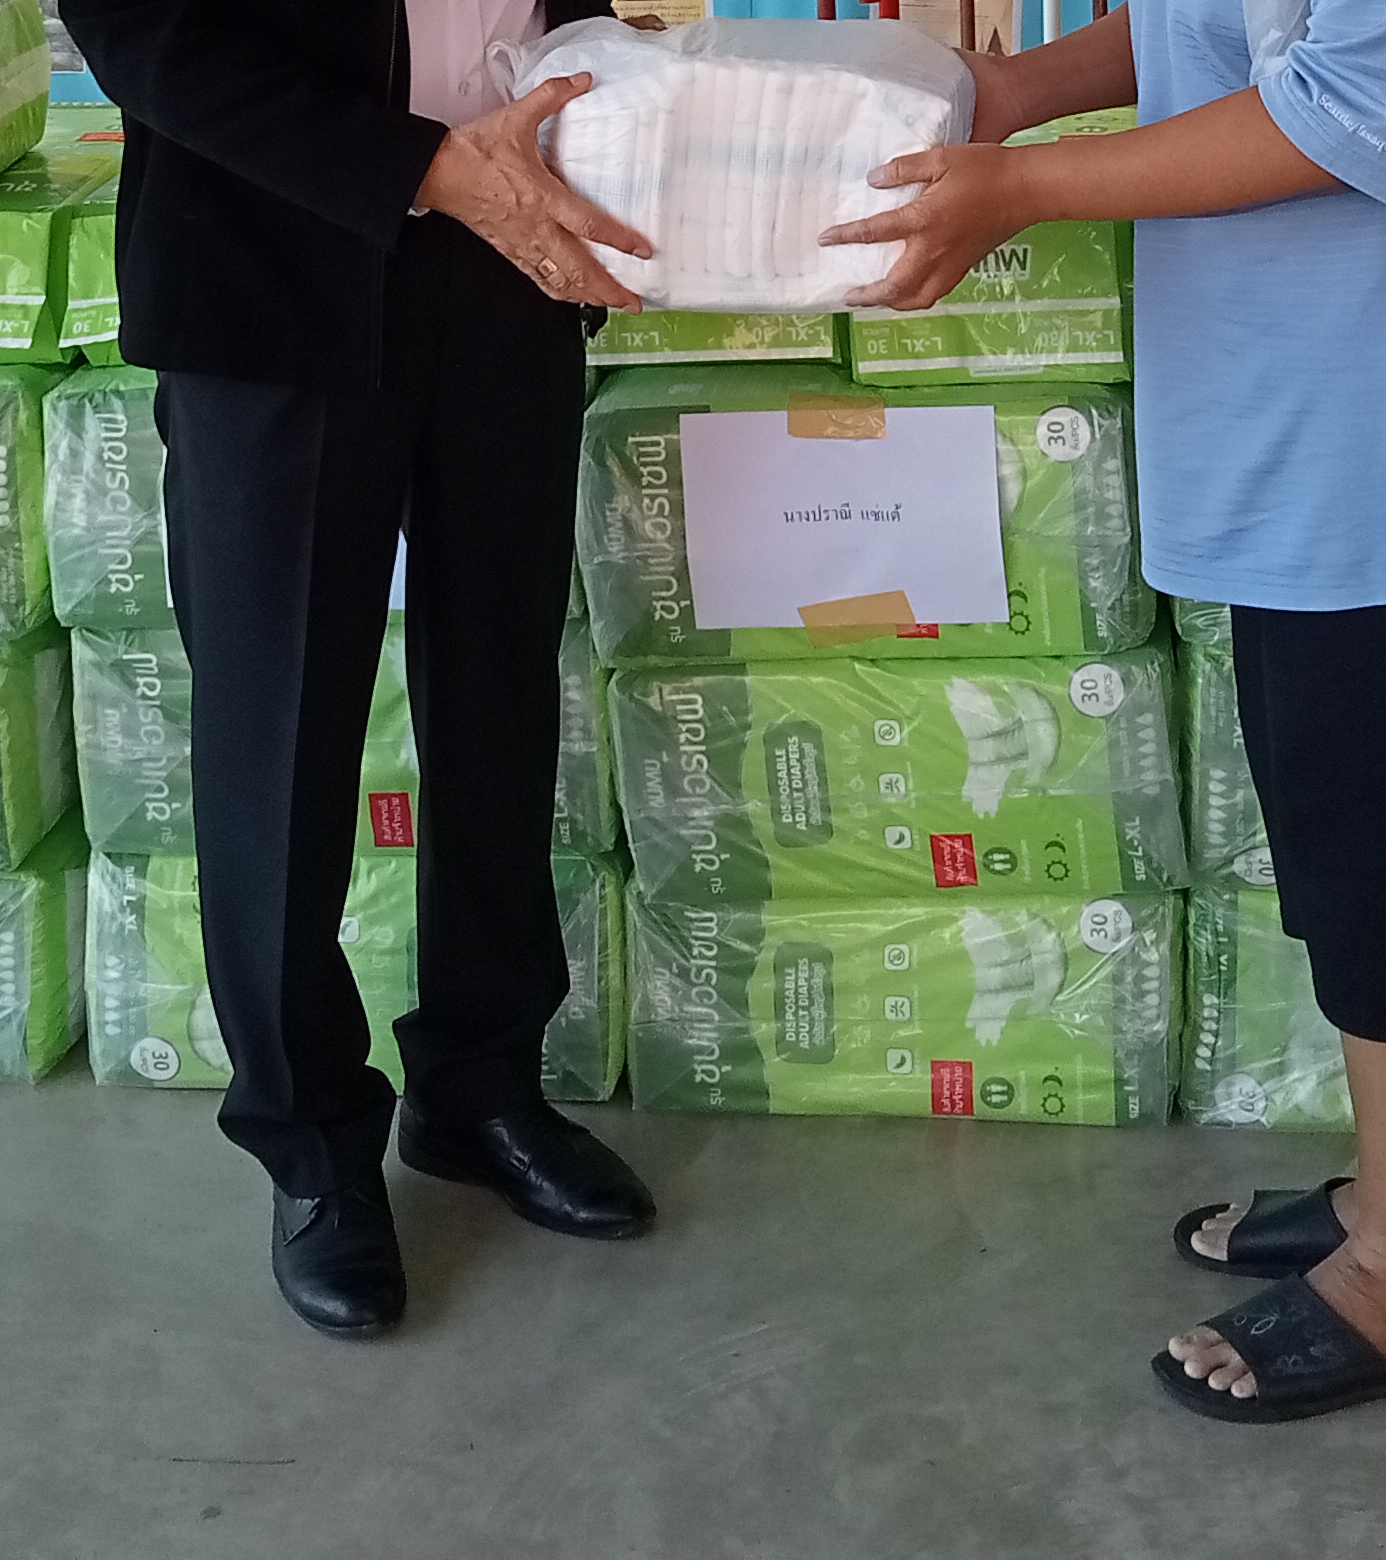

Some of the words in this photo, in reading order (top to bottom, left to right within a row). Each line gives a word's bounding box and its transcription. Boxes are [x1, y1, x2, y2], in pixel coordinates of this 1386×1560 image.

[72, 320, 91, 334] 30
[621, 331, 661, 348] L-XL
[786, 326, 827, 342] L-XL
[1071, 330, 1115, 346] L-XL
[868, 339, 888, 354] 30
[905, 337, 943, 353] L-XL
[1047, 420, 1065, 447] 30
[1080, 678, 1099, 704] 30
[788, 736, 803, 788] DIAPERS
[775, 748, 793, 823] DISPOSABLE
[793, 791, 807, 831] ADULT
[1124, 816, 1142, 857] L-XL
[1135, 859, 1147, 882] SIZE
[122, 894, 138, 936] L-XL
[1090, 913, 1107, 940] 30
[798, 958, 809, 1006] DIAPERS
[785, 967, 796, 1041] DISPOSABLE
[798, 1009, 809, 1049] ADULT
[152, 1050, 170, 1071] 30
